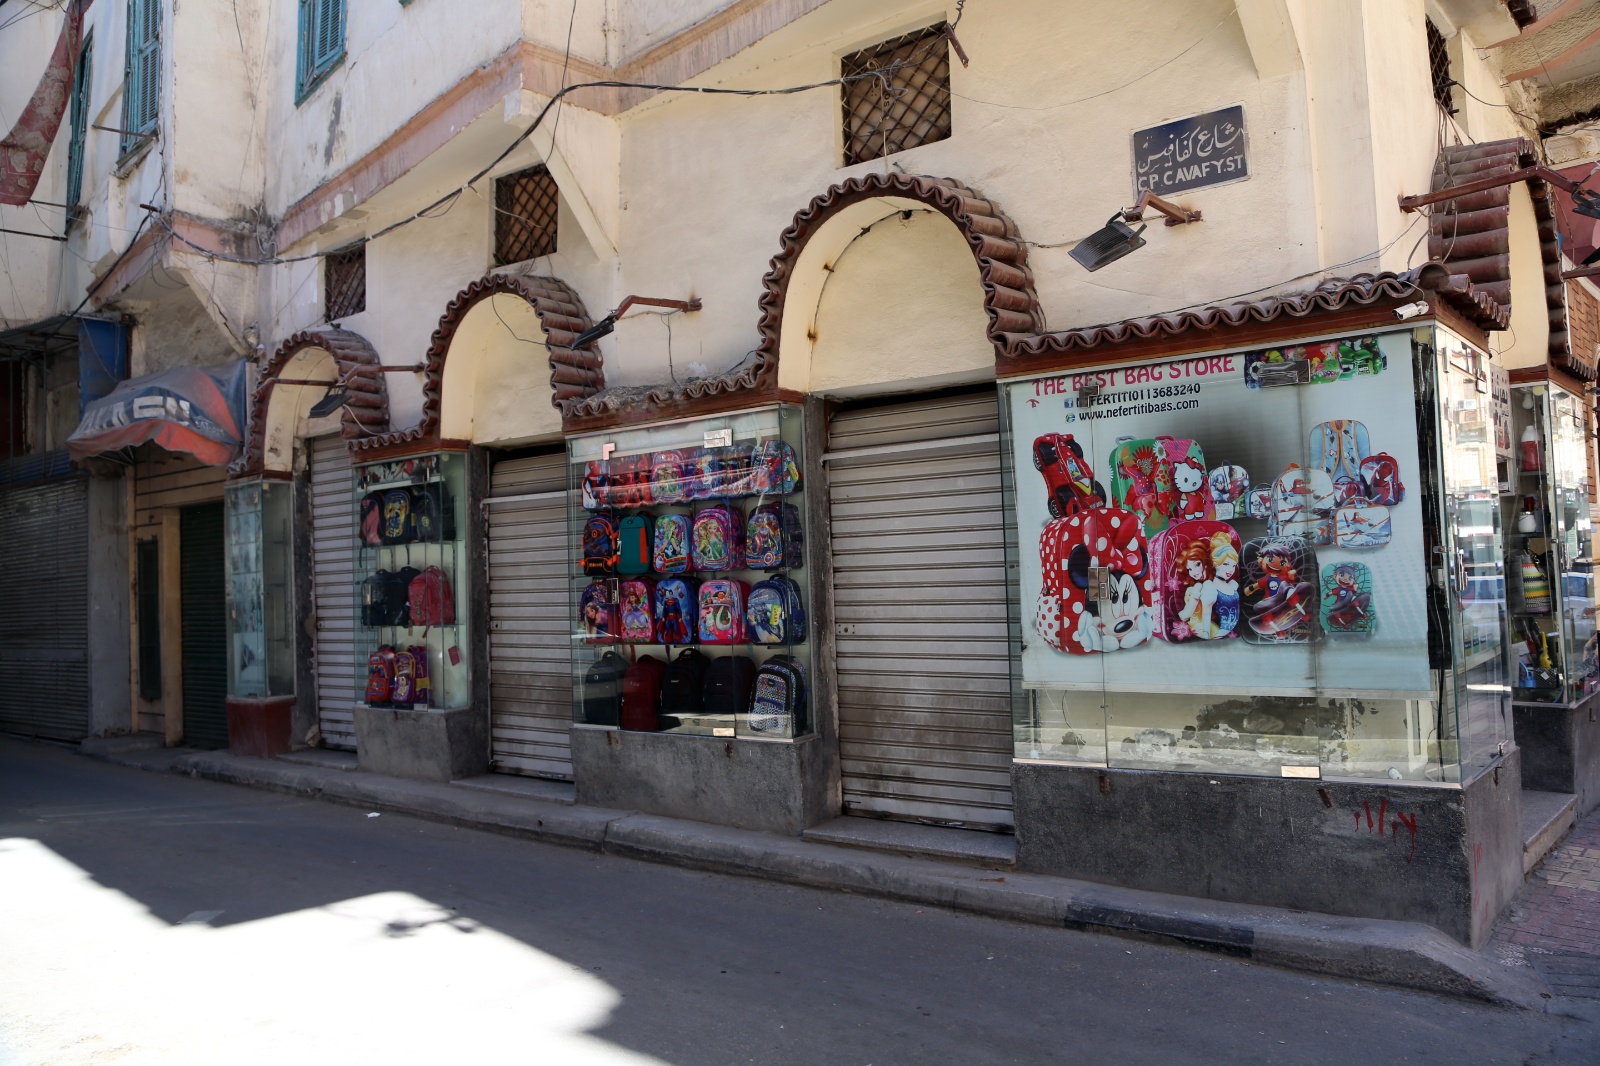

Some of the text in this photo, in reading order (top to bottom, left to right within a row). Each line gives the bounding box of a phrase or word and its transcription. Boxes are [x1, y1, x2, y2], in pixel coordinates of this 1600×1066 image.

[1196, 121, 1243, 157] شارع
[1032, 355, 1236, 397] THE BEST BAG STORE
[1079, 398, 1199, 421] www.nefertitibags.com
